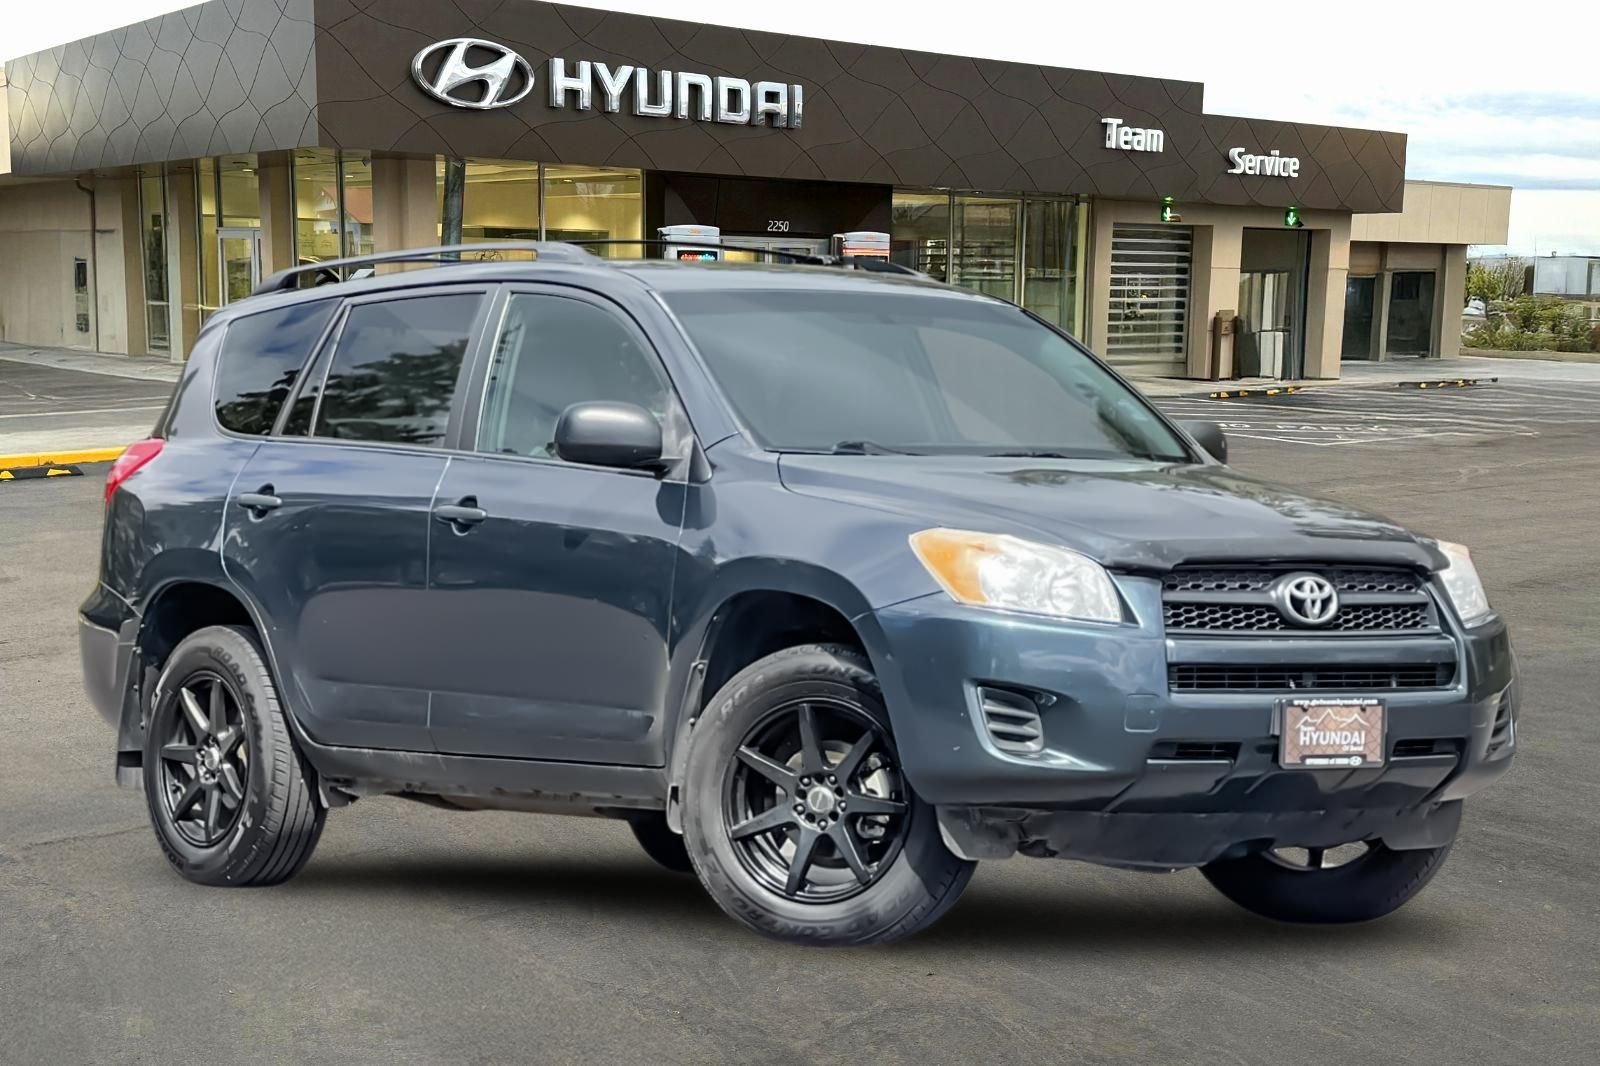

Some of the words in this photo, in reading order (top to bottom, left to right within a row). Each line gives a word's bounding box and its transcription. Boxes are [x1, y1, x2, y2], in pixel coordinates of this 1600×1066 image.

[548, 57, 803, 129] HYUNDAI
[1101, 117, 1164, 153] Team
[1227, 147, 1300, 178] Service
[767, 220, 790, 232] 2250
[1299, 730, 1366, 746] HYUNDAI
